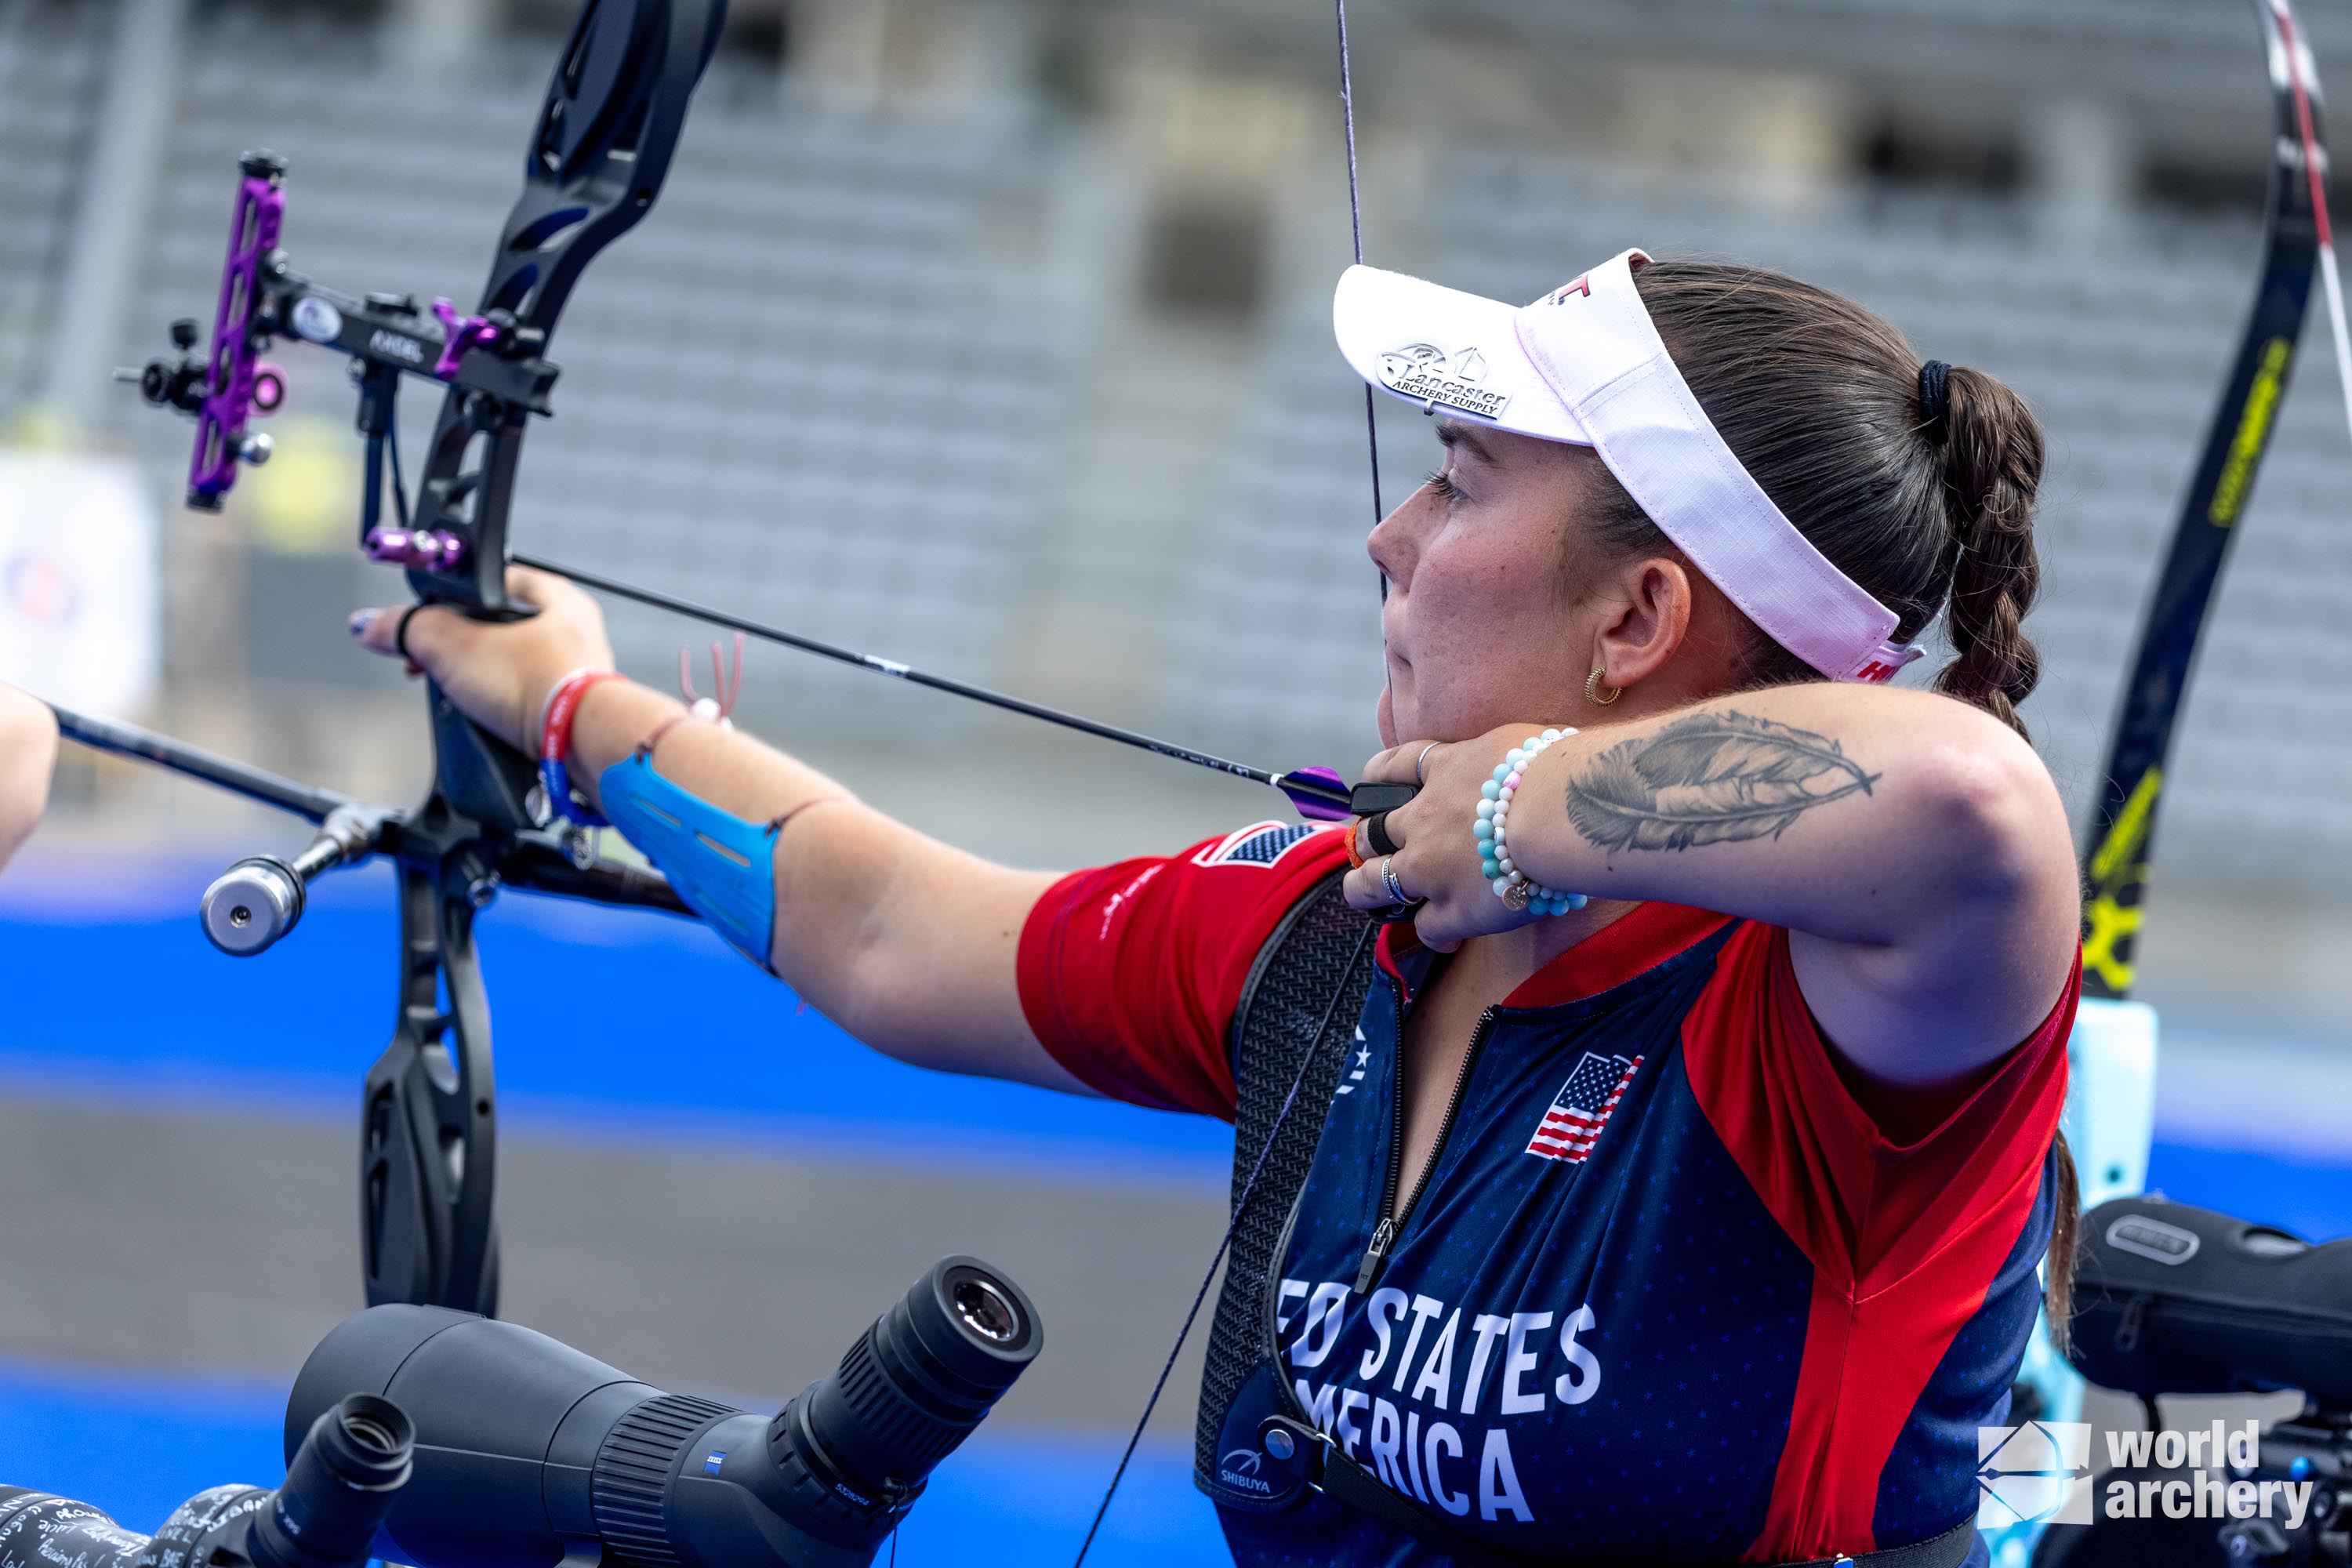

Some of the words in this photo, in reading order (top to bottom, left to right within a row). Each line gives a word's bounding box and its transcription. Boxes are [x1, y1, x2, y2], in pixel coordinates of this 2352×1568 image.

[1392, 381, 1452, 402] ARCHERY
[1450, 396, 1498, 415] SUPPLY
[1399, 364, 1506, 406] Lancaster
[1359, 1287, 1601, 1415] STATES
[1221, 1469, 1270, 1494] SHIBUYA
